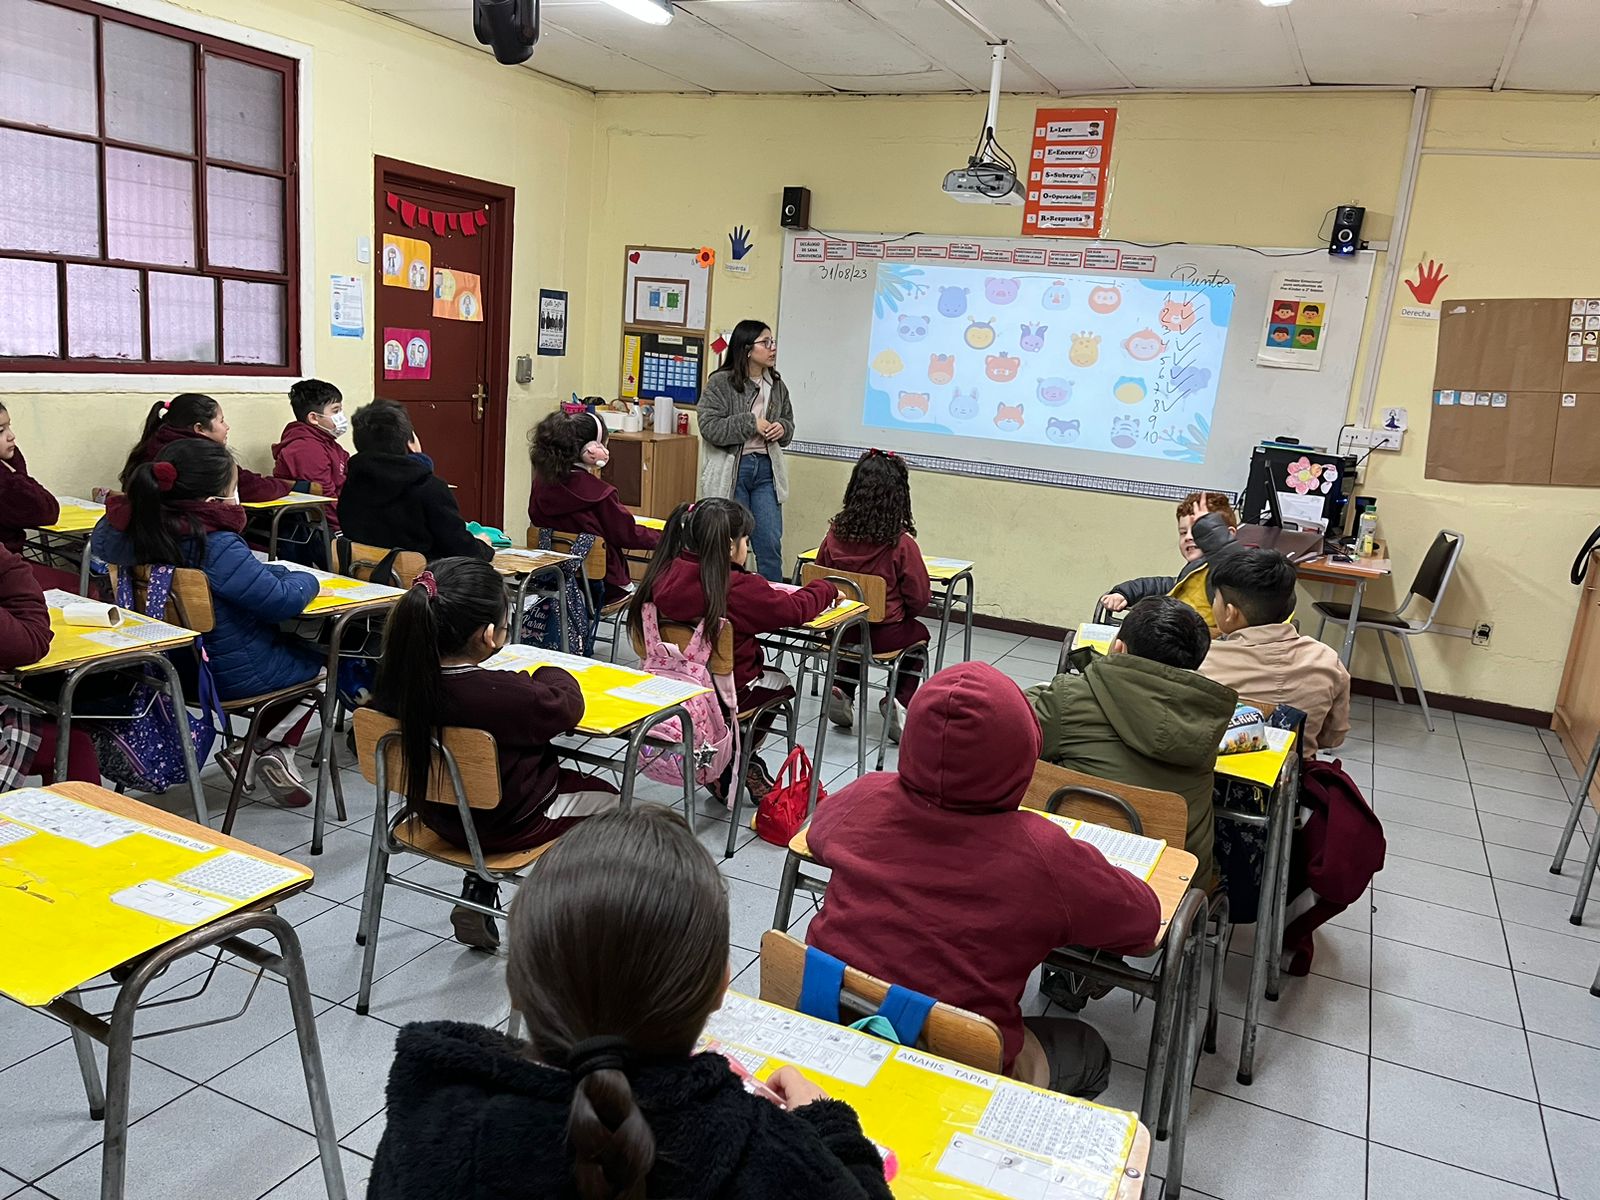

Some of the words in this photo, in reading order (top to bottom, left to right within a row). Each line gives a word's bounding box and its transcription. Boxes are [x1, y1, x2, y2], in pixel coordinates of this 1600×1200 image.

[818, 263, 868, 282] 31/08/23
[1170, 264, 1231, 288] Puntos
[1161, 308, 1172, 324] 2
[1401, 308, 1436, 318] Derecha
[1161, 325, 1172, 335] 3
[1160, 339, 1170, 353] 4
[1160, 355, 1172, 366] 5
[1153, 399, 1160, 413] 8
[1148, 415, 1157, 430] 9
[1143, 431, 1159, 445] 10
[897, 1050, 945, 1073] ANAHIS
[953, 1068, 990, 1087] TAPIA
